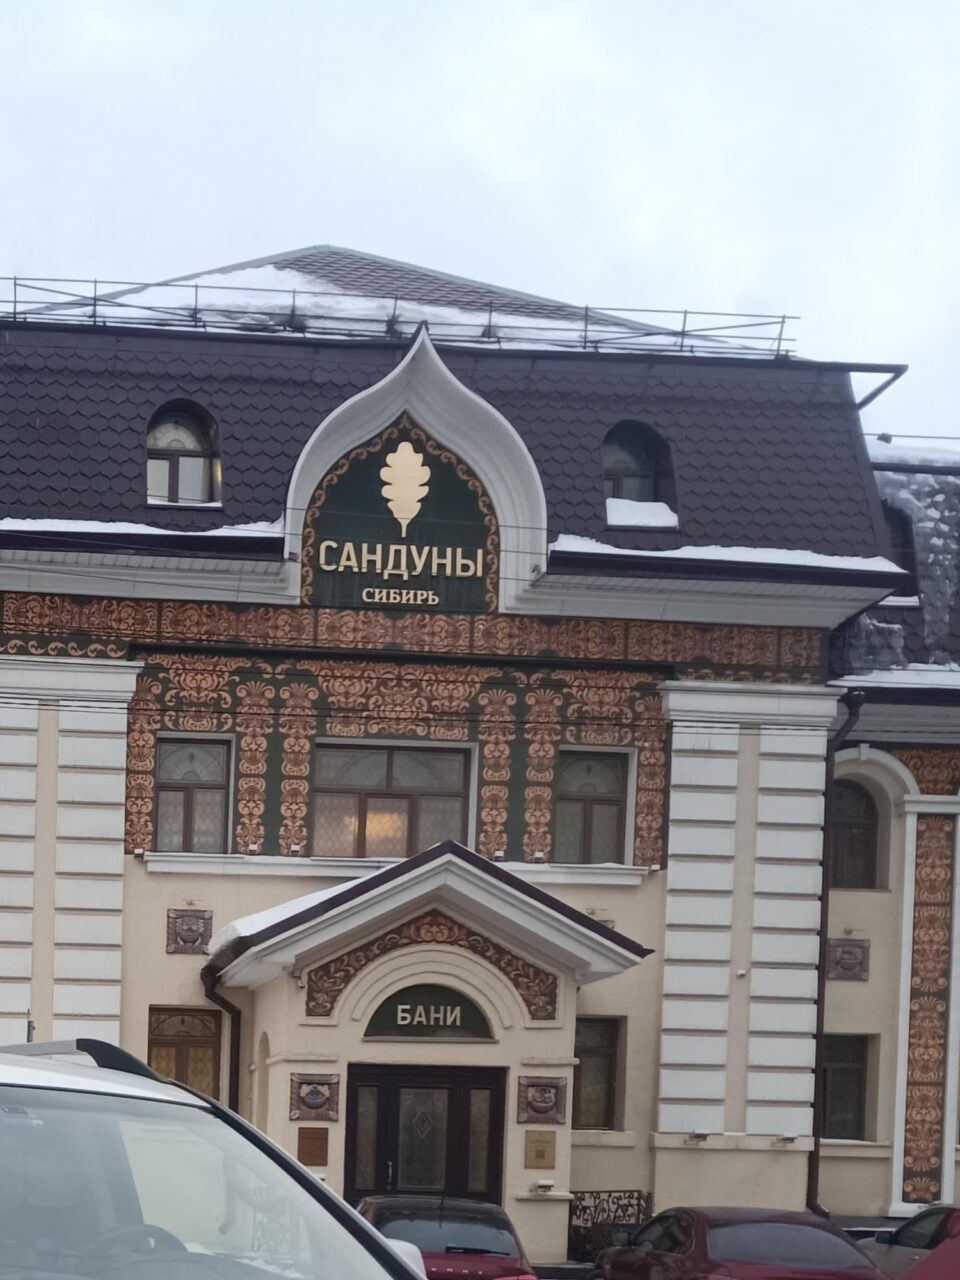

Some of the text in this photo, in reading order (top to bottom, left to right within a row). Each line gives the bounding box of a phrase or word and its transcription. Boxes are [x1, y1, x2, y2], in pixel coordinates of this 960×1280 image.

[318, 540, 484, 581] САНДУНЫ
[361, 587, 440, 606] СИБИРЬ
[396, 1004, 462, 1027] БАНИ
